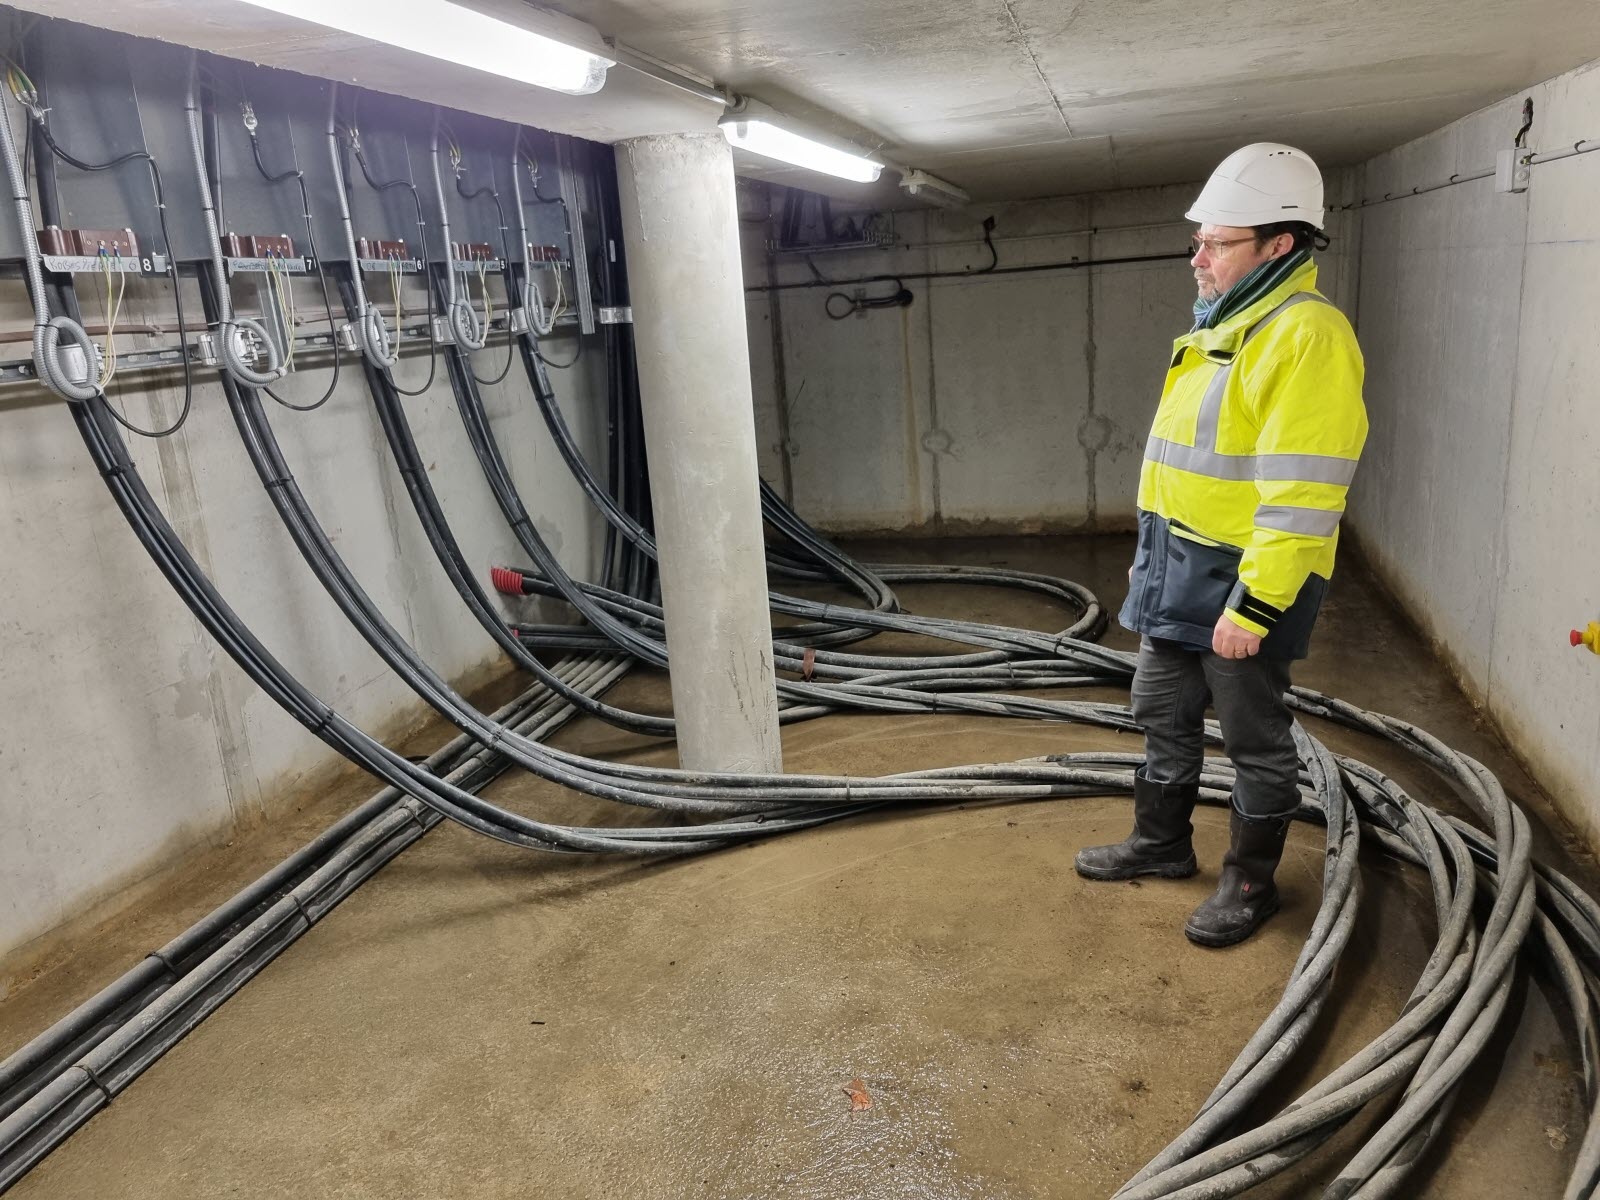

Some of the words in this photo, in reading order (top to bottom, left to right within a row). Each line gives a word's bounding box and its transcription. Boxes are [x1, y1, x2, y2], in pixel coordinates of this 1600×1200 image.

[142, 258, 152, 271] 8
[306, 259, 312, 271] 7
[416, 259, 423, 270] 6
[500, 260, 505, 270] 5
